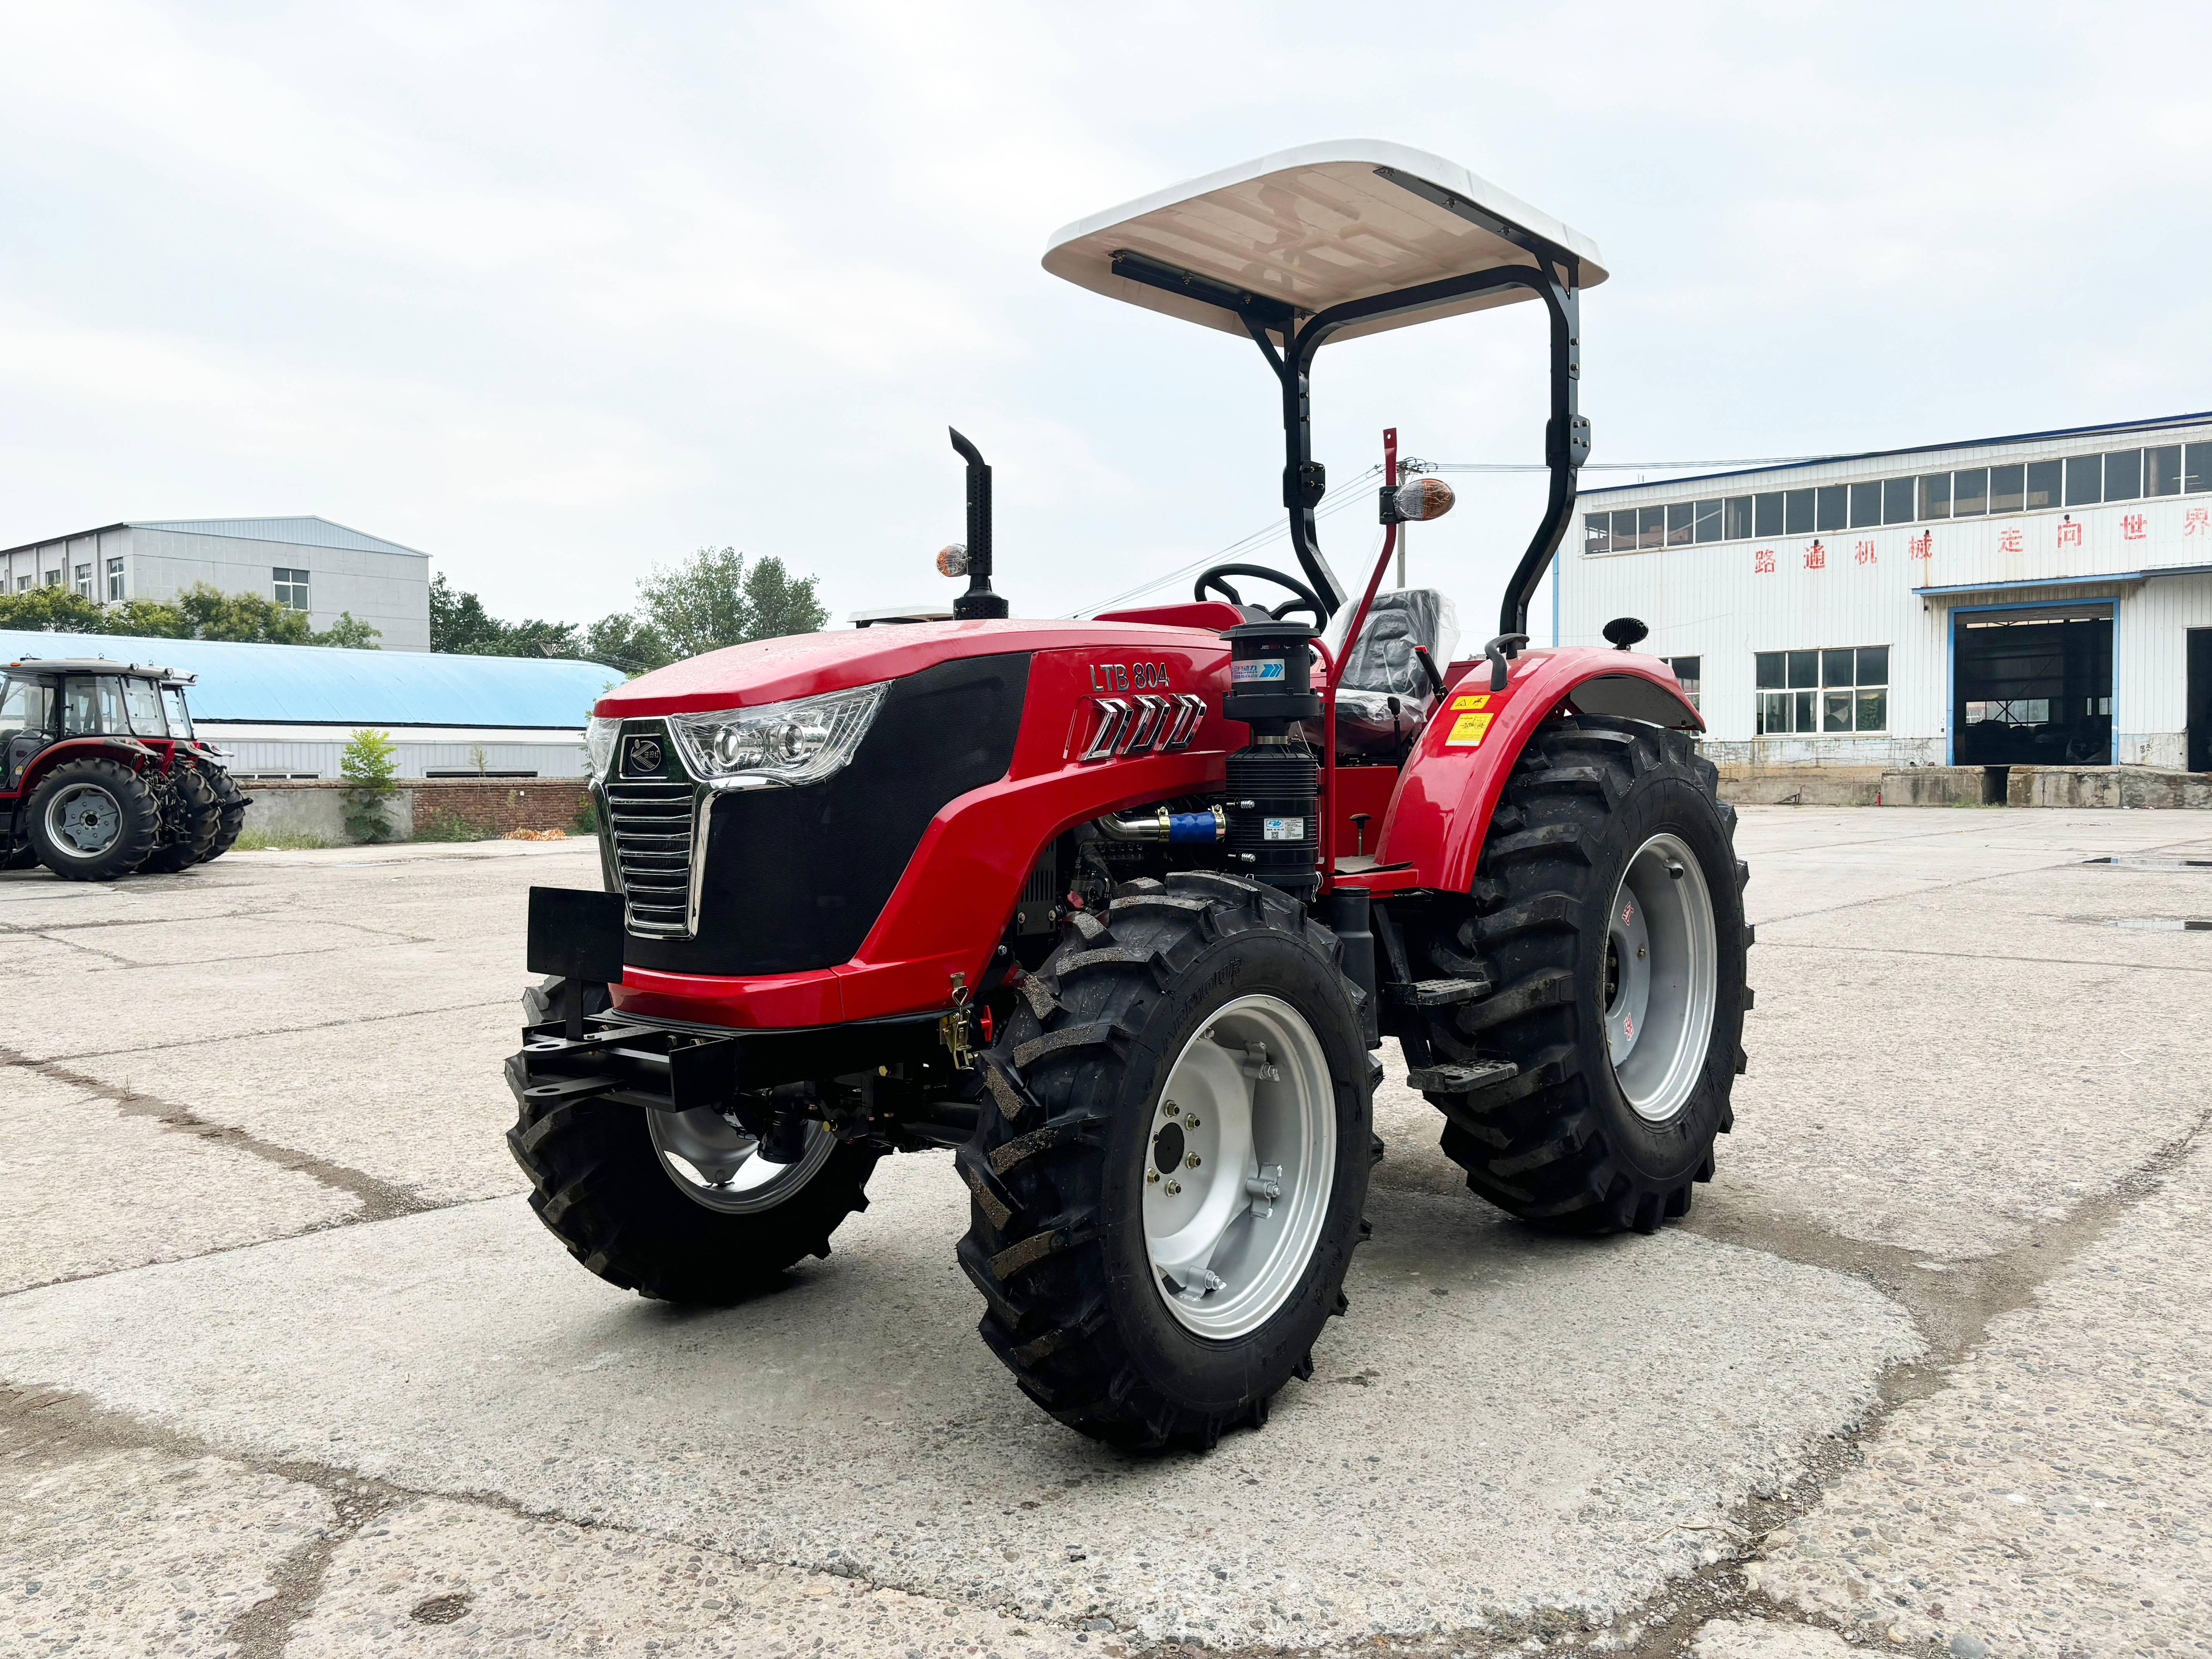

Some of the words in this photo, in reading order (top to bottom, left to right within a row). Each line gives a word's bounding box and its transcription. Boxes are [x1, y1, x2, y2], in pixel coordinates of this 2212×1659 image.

[1755, 534, 1932, 574] 路通机械
[1998, 507, 2211, 552] 走向世界
[1089, 664, 1129, 691] LTB
[1133, 662, 1170, 689] 804
[1163, 958, 1242, 1056] ARMOUR
